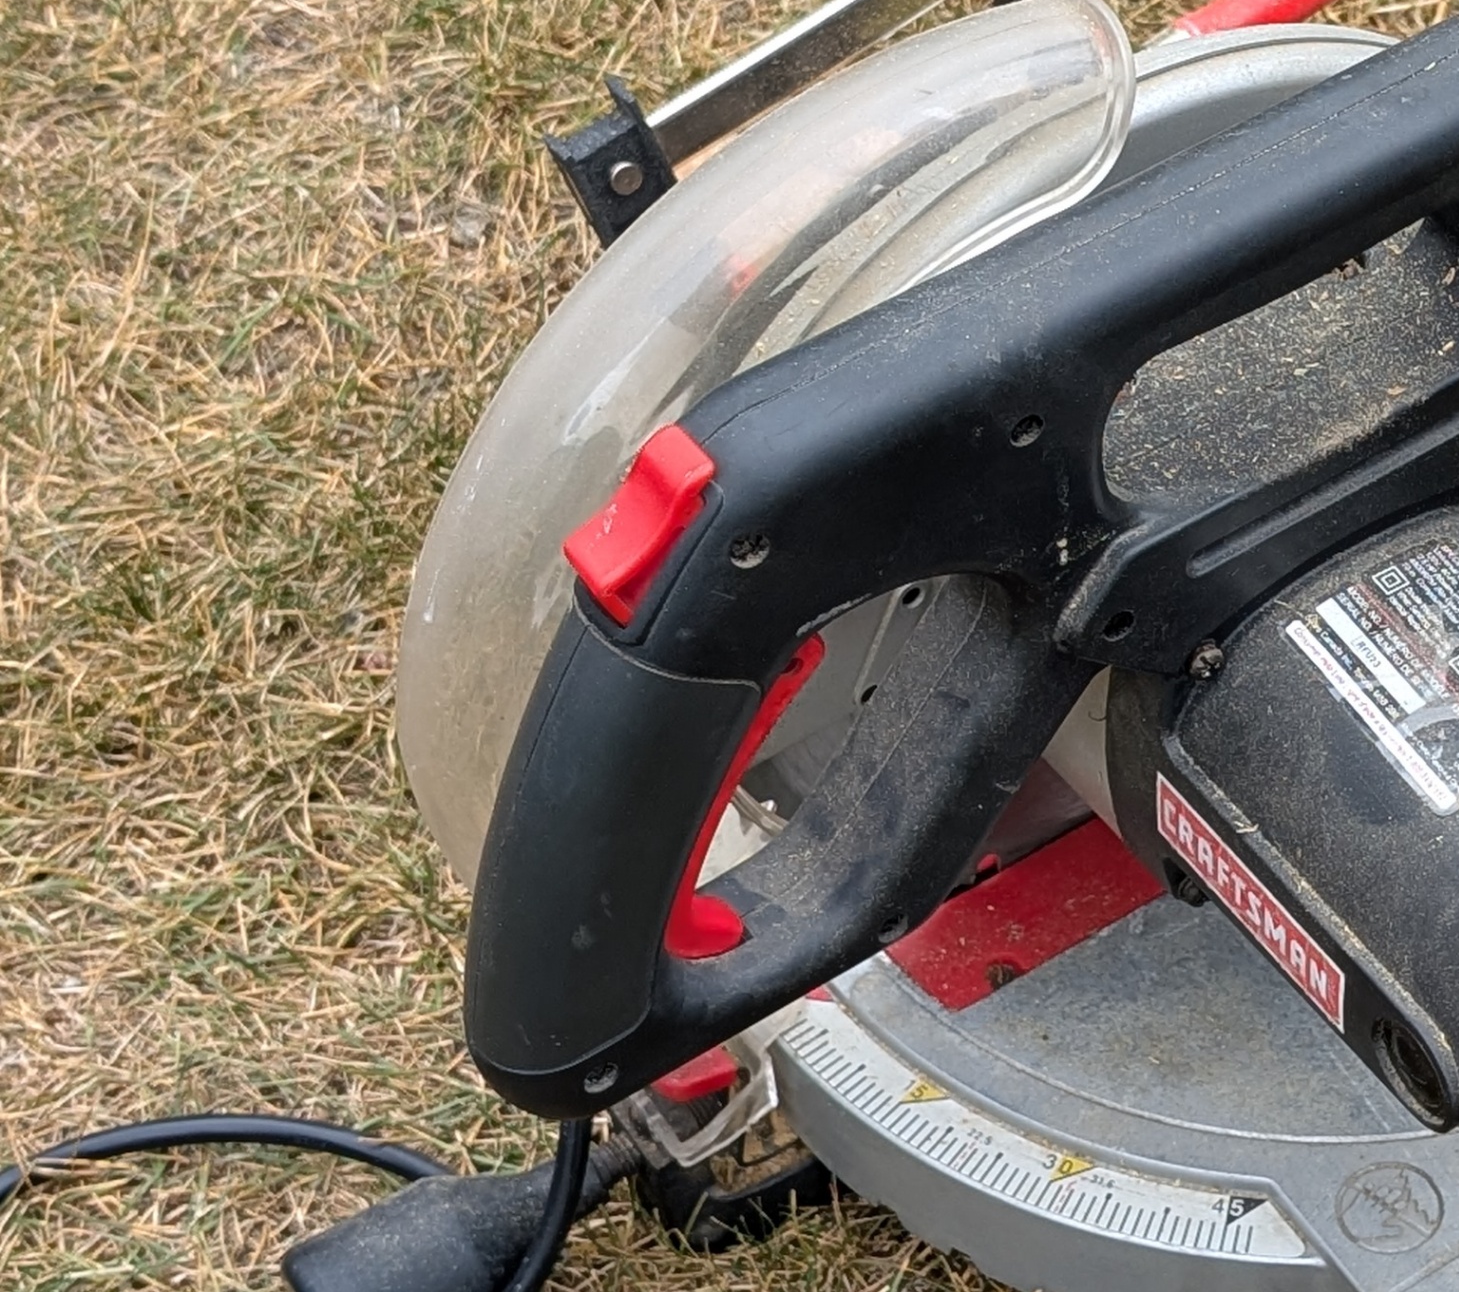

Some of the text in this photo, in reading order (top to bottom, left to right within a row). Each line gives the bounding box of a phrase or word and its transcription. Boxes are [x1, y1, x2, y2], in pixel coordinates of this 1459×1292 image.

[1162, 797, 1330, 1003] CRAFTSMAN
[966, 1127, 993, 1146] 22.5
[1042, 1153, 1075, 1175] 30
[1211, 1197, 1245, 1217] 45
